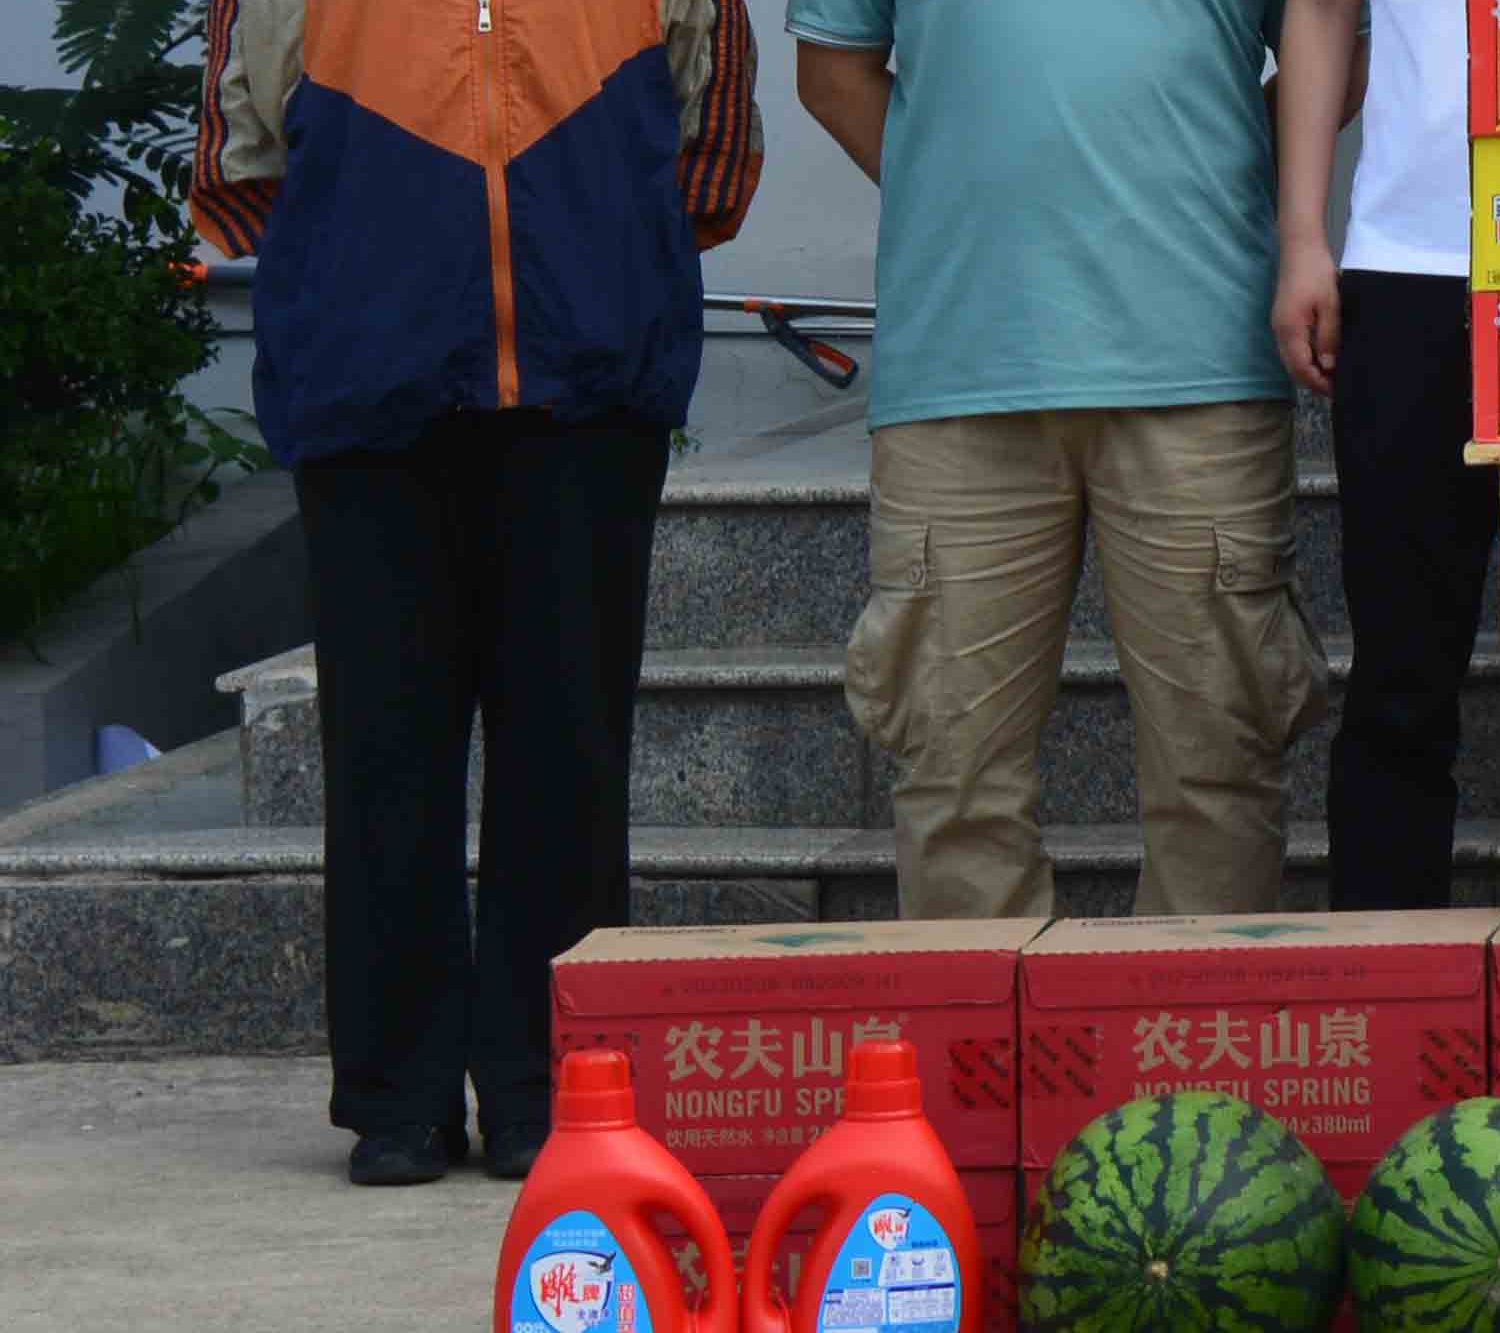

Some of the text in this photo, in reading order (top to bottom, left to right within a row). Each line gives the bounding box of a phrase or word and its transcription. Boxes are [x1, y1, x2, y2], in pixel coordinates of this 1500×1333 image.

[1133, 1008, 1372, 1070] 农夫山泉
[665, 1088, 782, 1119] NONGFU
[1264, 1077, 1371, 1106] SPRING
